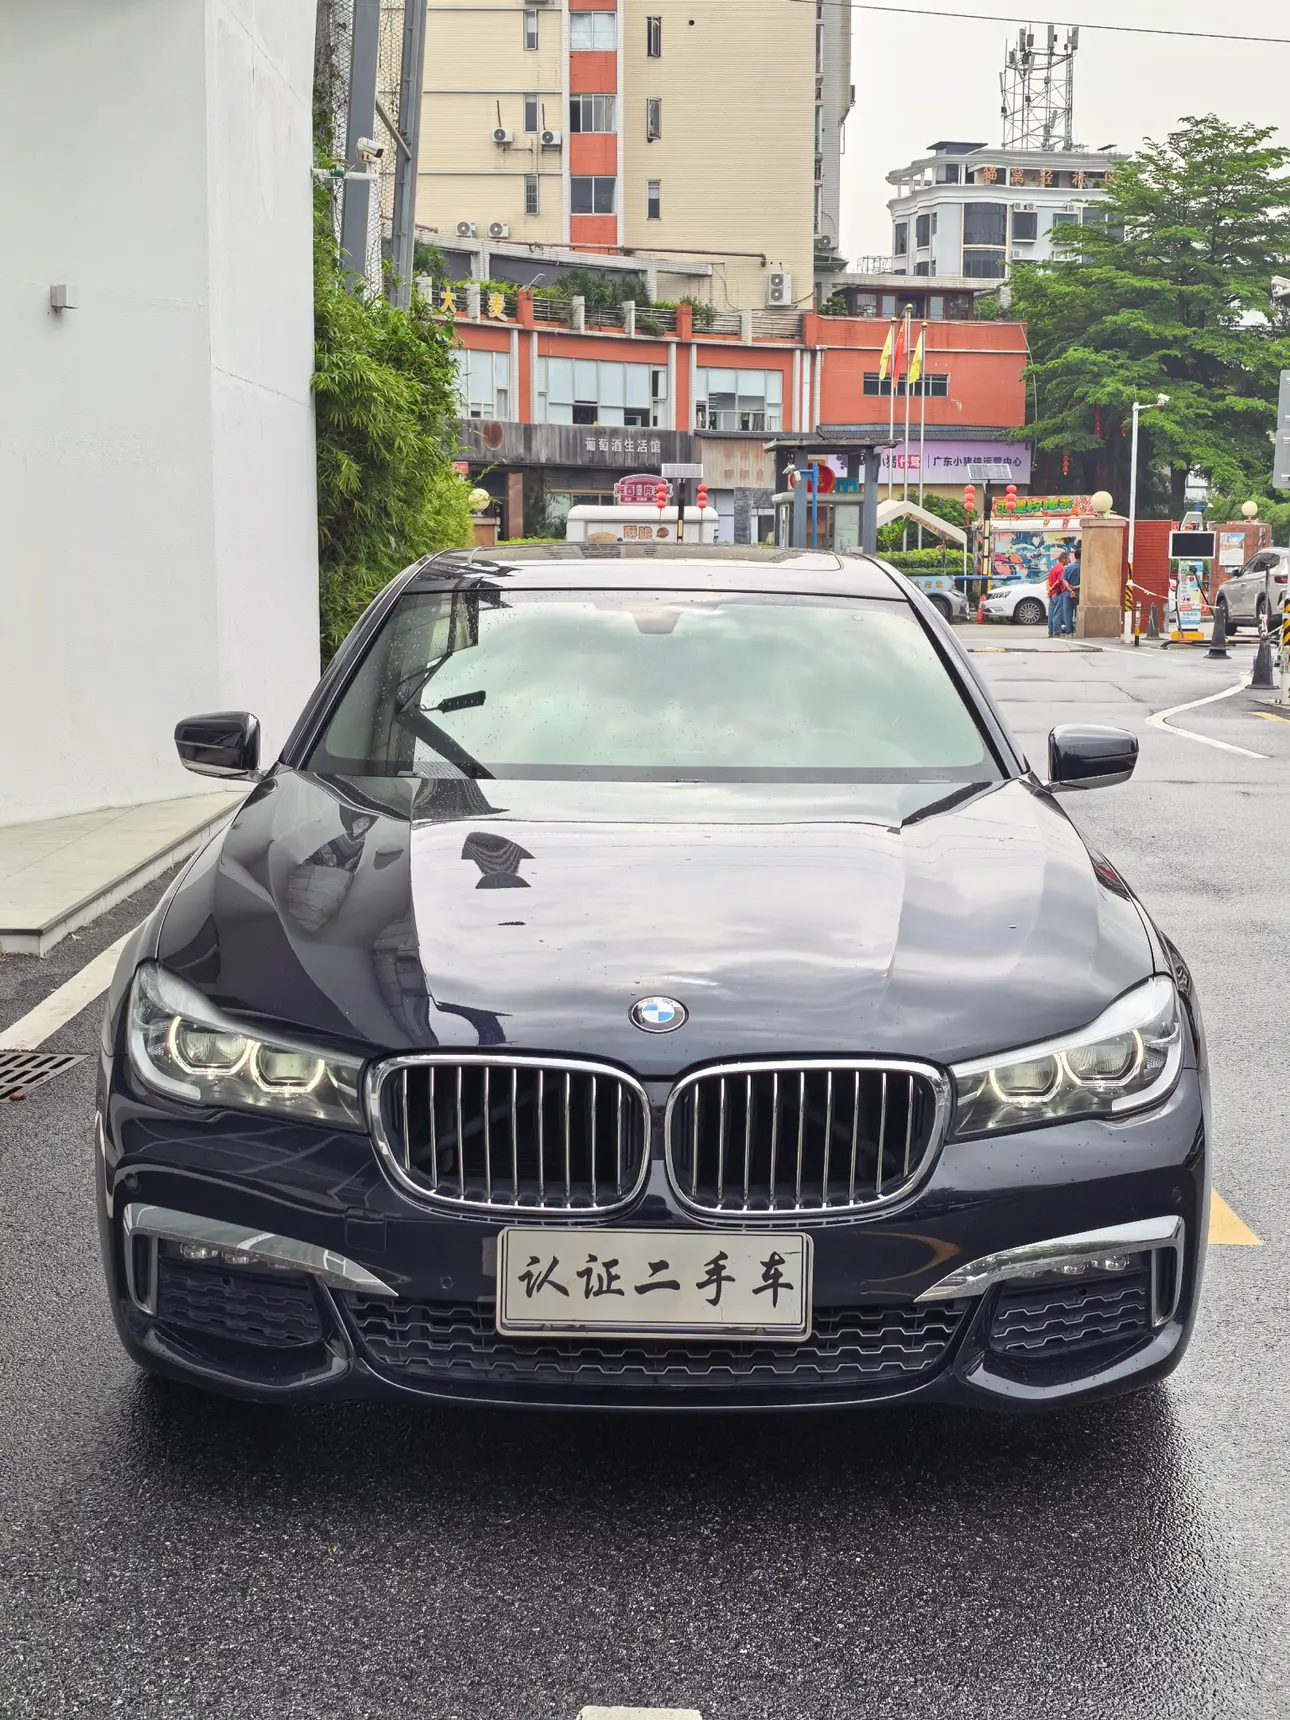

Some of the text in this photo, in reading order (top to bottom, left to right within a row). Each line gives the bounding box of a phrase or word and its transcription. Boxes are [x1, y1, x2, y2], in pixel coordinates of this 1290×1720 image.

[585, 437, 661, 454] 葡萄酒生活馆
[518, 1251, 794, 1308] 认证二手车
